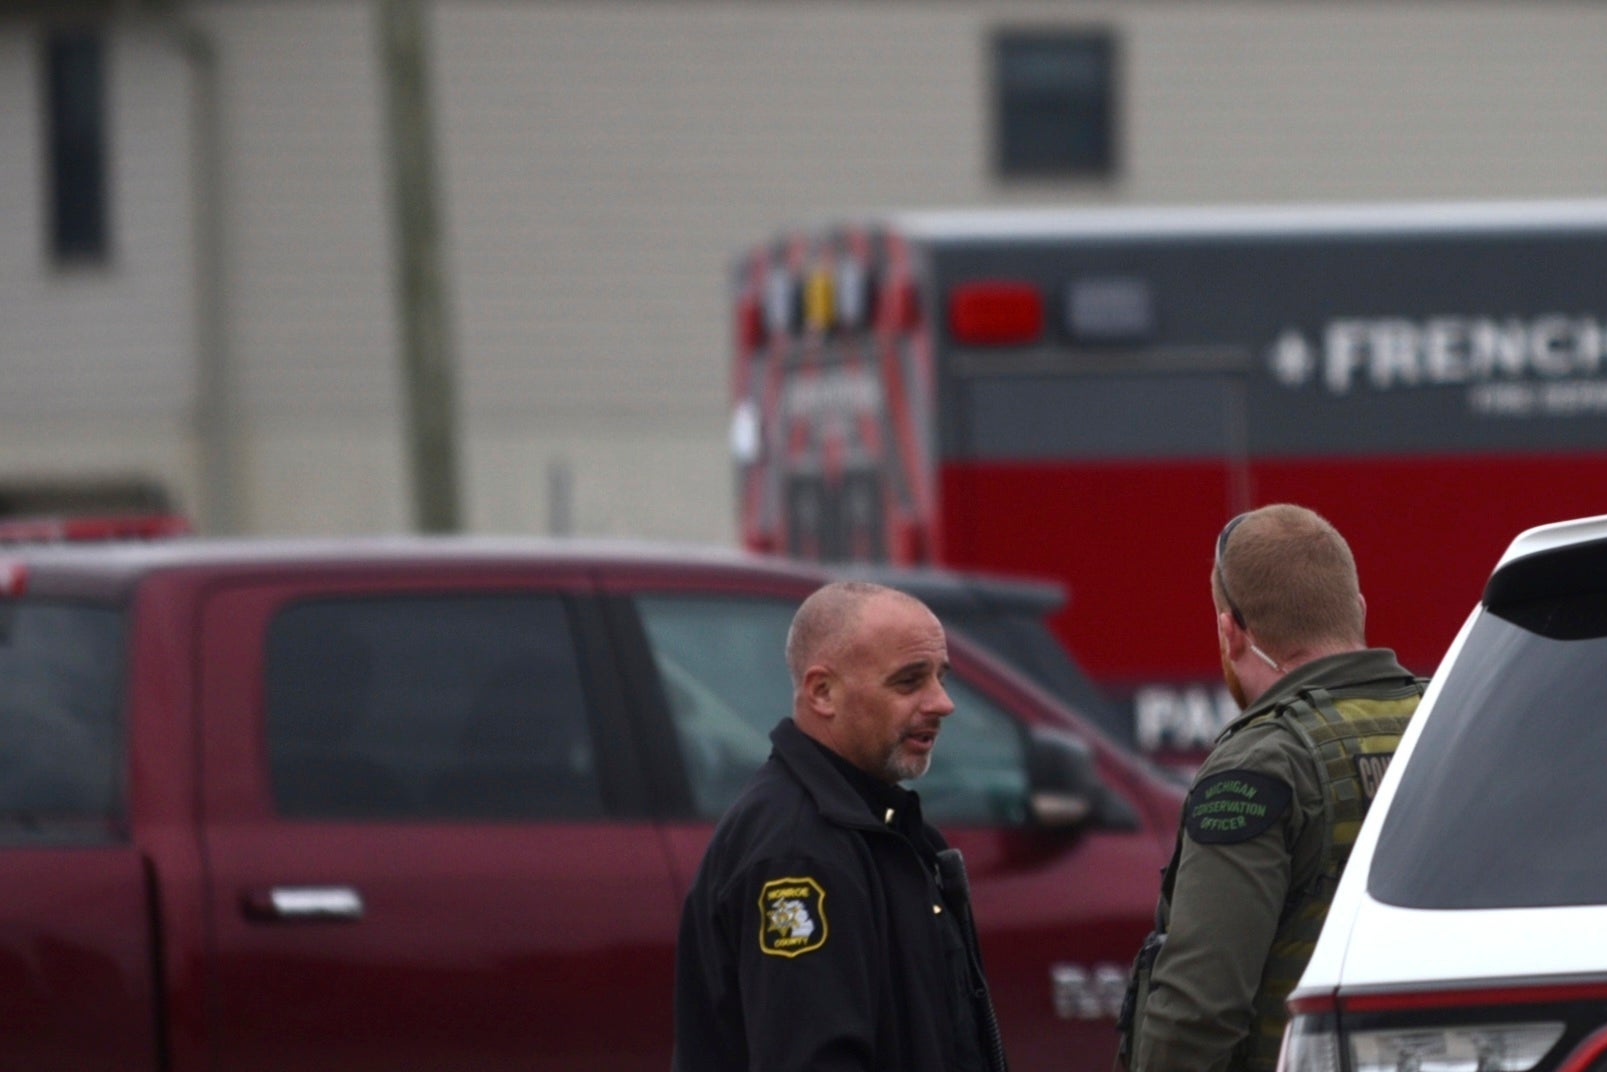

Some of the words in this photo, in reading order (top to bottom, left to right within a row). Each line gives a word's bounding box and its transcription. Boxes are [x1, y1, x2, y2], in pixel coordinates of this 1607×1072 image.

[1205, 780, 1257, 799] MICHIGAN
[1193, 800, 1267, 817] CONSERVATION
[1201, 815, 1246, 832] OFFICER
